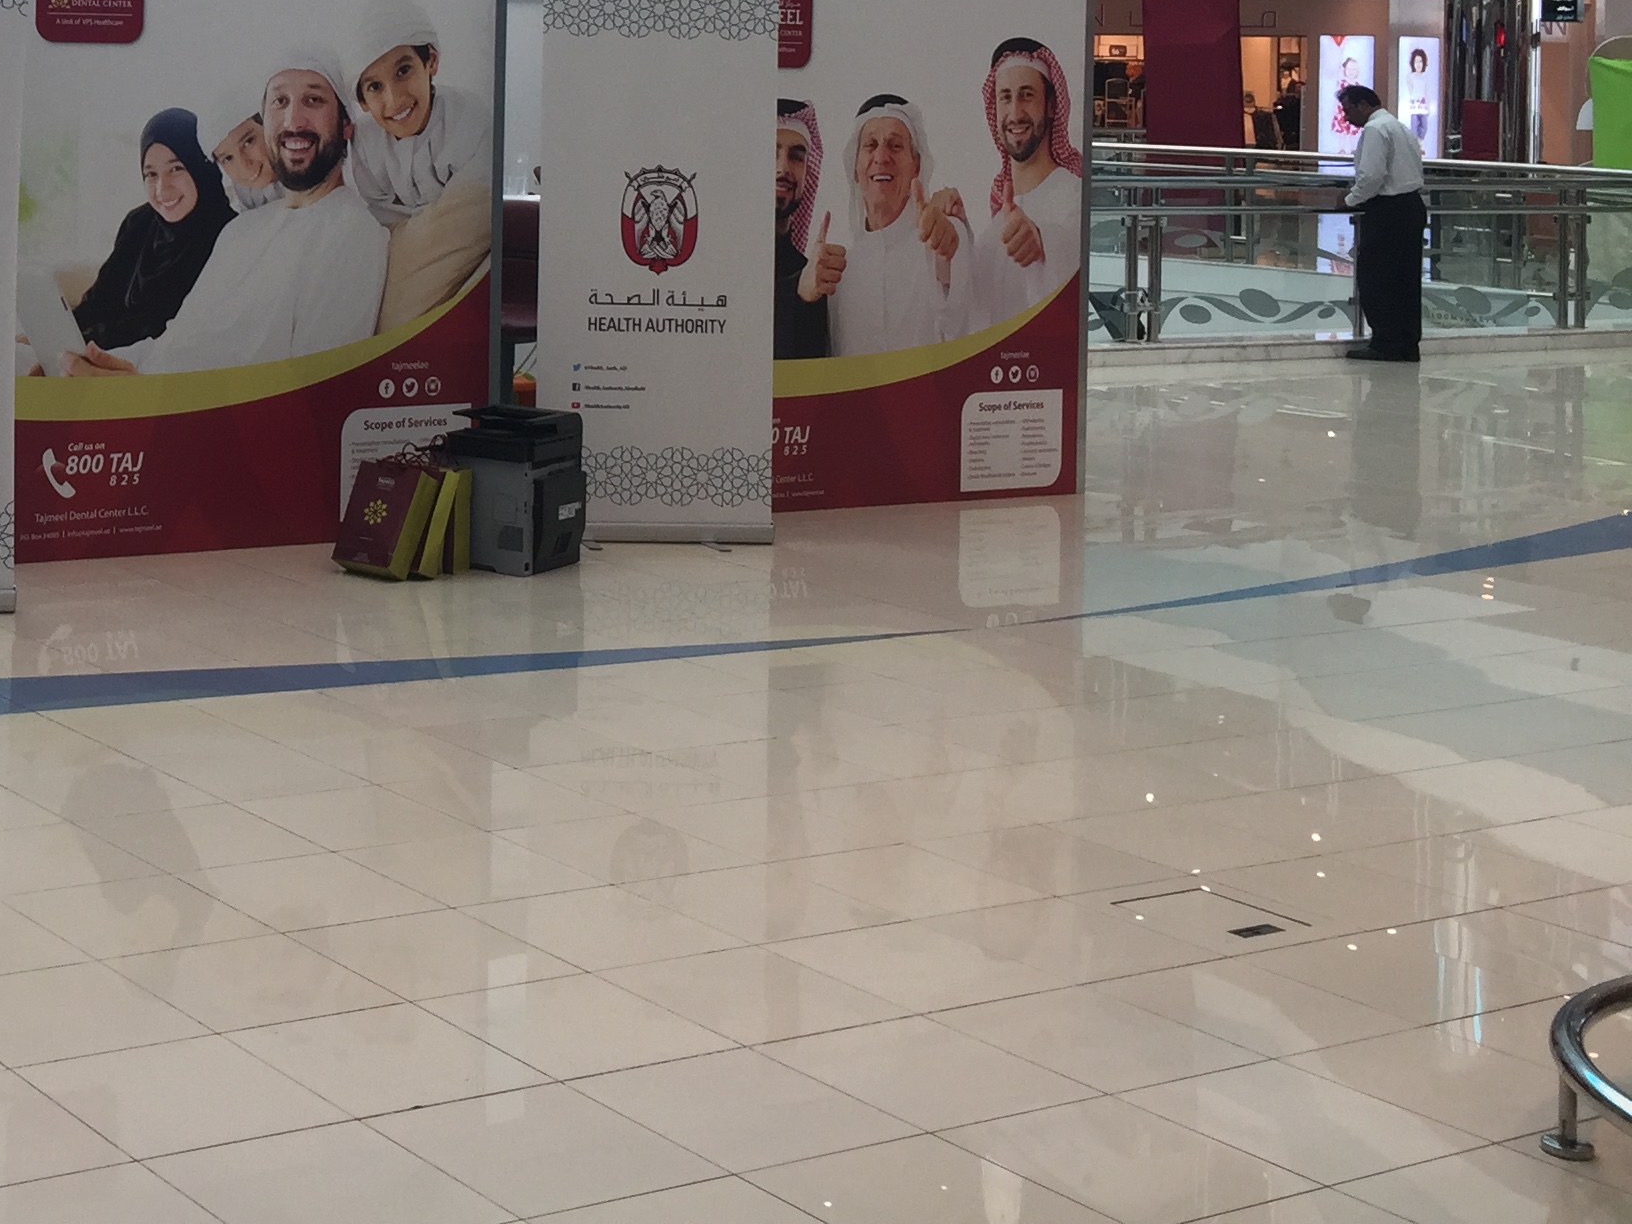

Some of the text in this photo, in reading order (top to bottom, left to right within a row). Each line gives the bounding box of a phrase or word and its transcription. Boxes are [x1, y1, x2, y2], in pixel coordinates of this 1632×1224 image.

[102, 0, 133, 8] CENTER
[588, 288, 727, 312] هيئة الصحة
[588, 317, 727, 334] HEALTH AUTHORITY
[978, 400, 1044, 413] Scope of Services
[363, 416, 448, 432] Scope of Services
[784, 425, 811, 444] TAJ
[68, 442, 83, 452] Call
[95, 442, 106, 450] on
[65, 451, 145, 475] 800 TAJ
[35, 505, 150, 525] Tajmeel Dental Center L.L.C.
